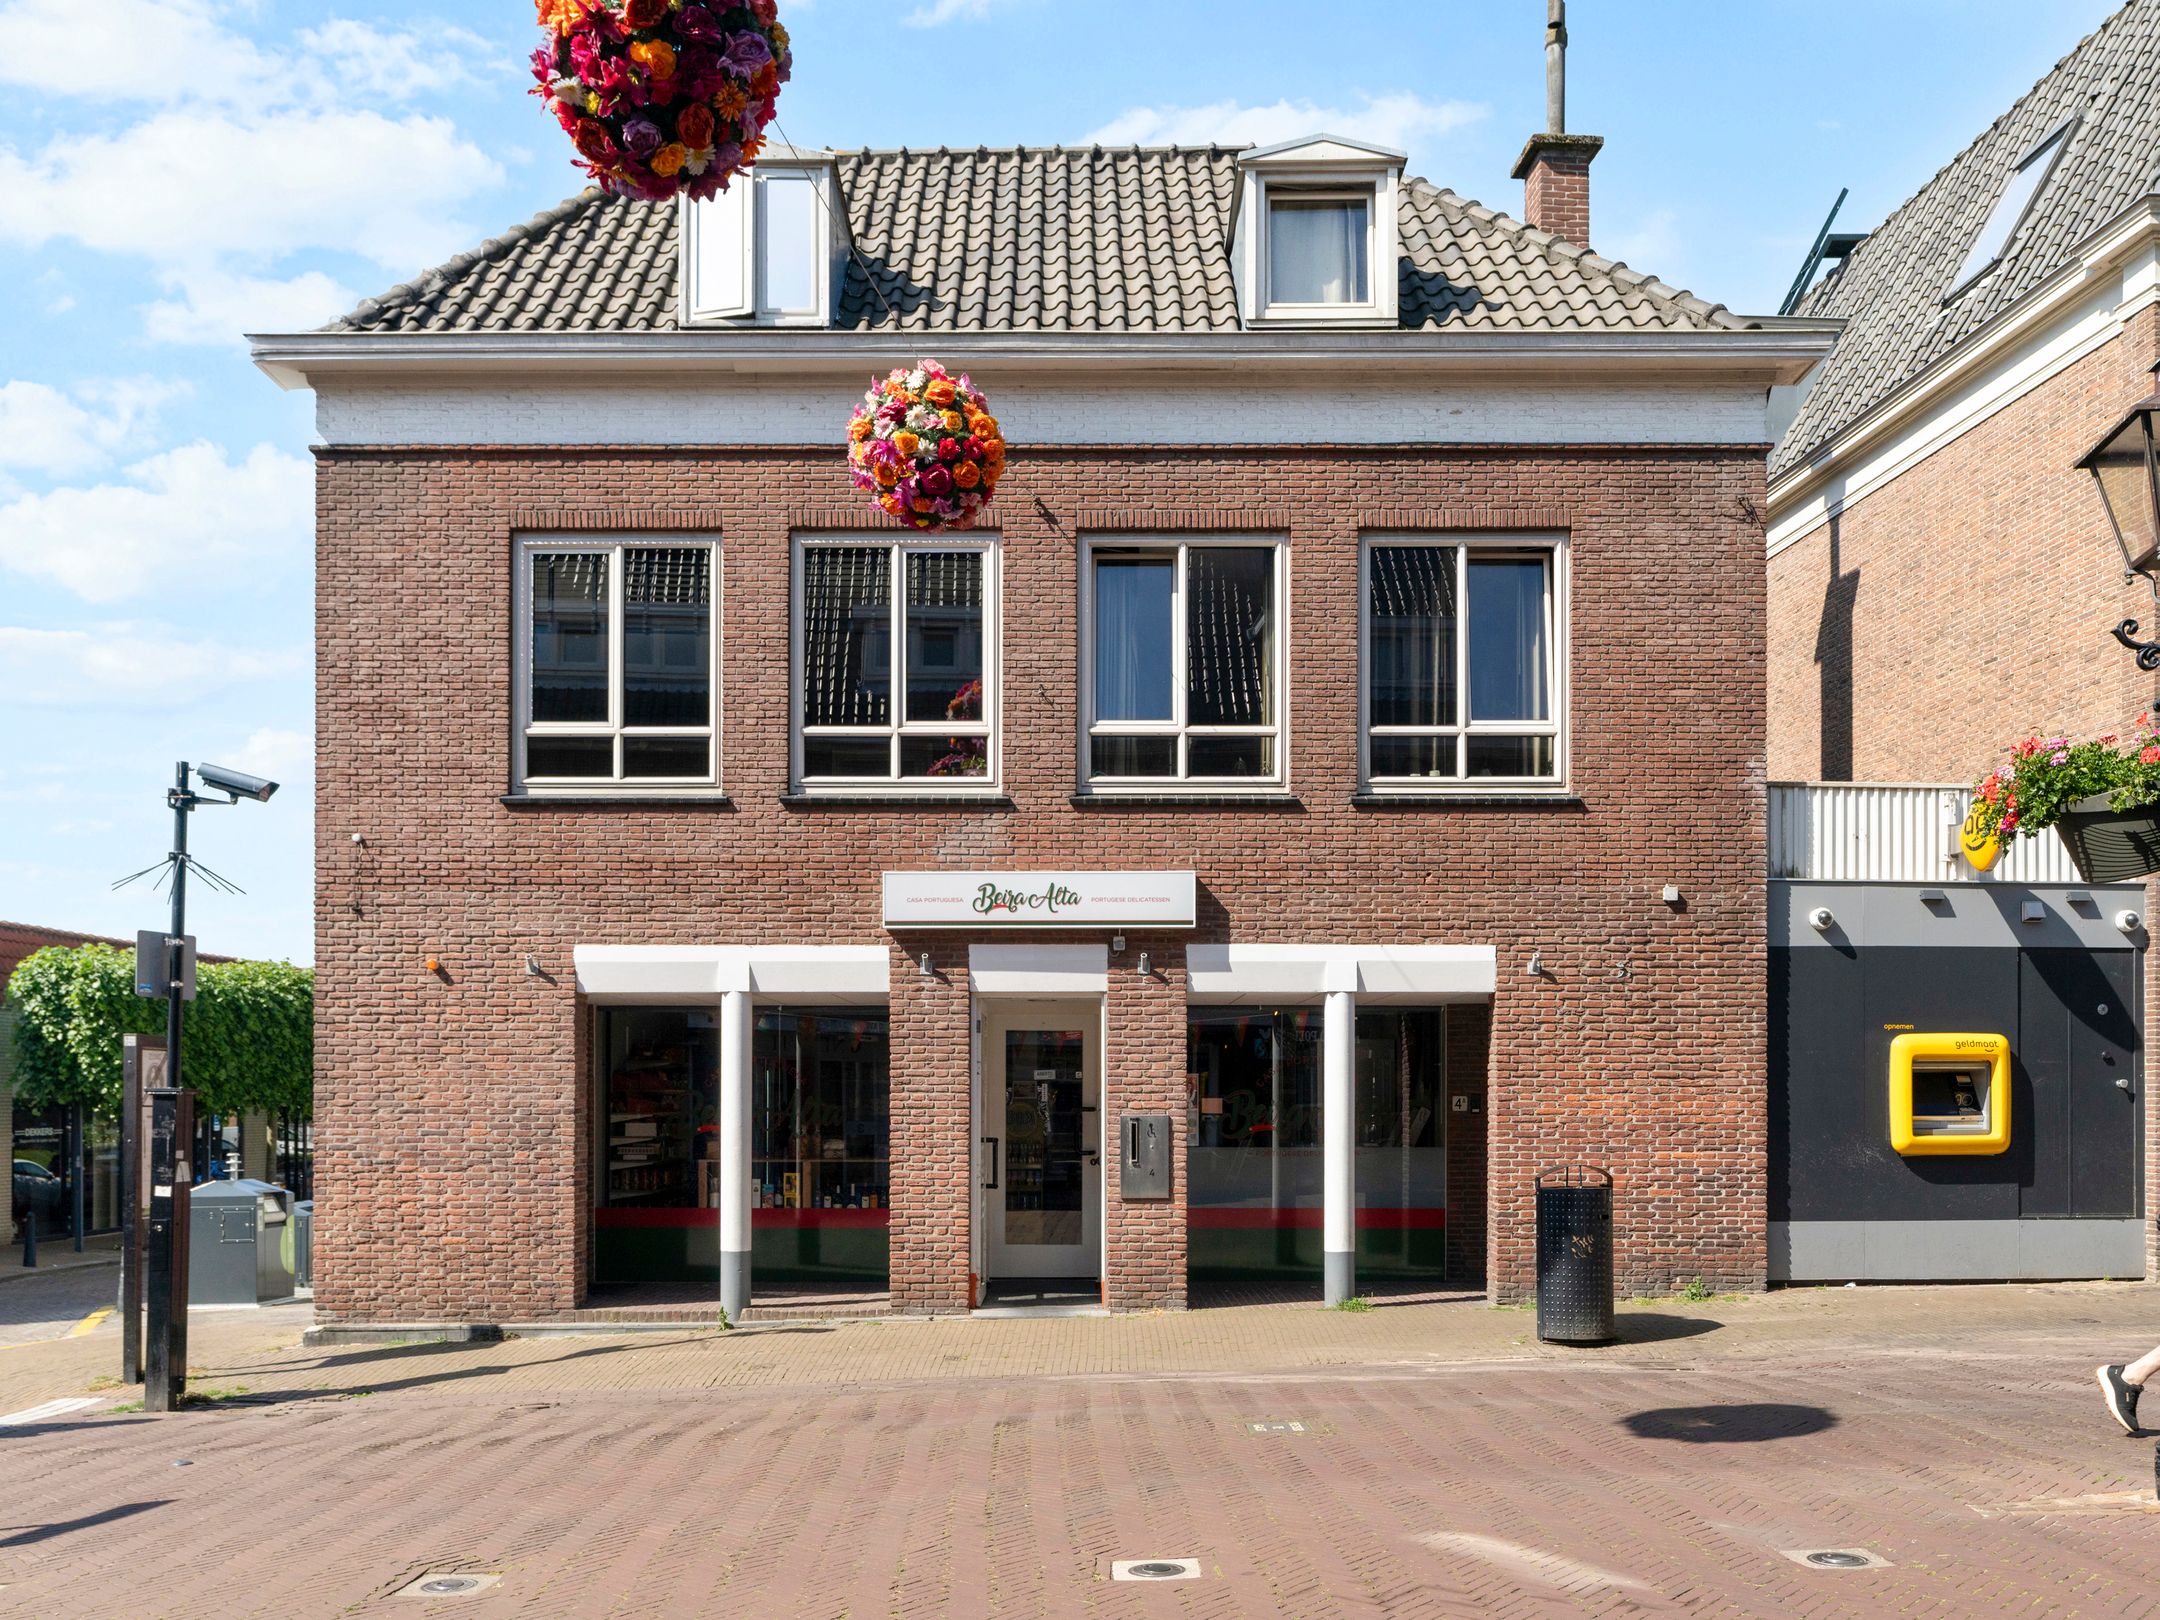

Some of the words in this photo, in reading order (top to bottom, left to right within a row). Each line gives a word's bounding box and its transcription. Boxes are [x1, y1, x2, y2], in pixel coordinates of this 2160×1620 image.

[972, 882, 1027, 915] Beira
[1028, 882, 1082, 913] Alta
[1883, 1023, 1915, 1031] opnemen
[1955, 1040, 1999, 1050] geldmaat
